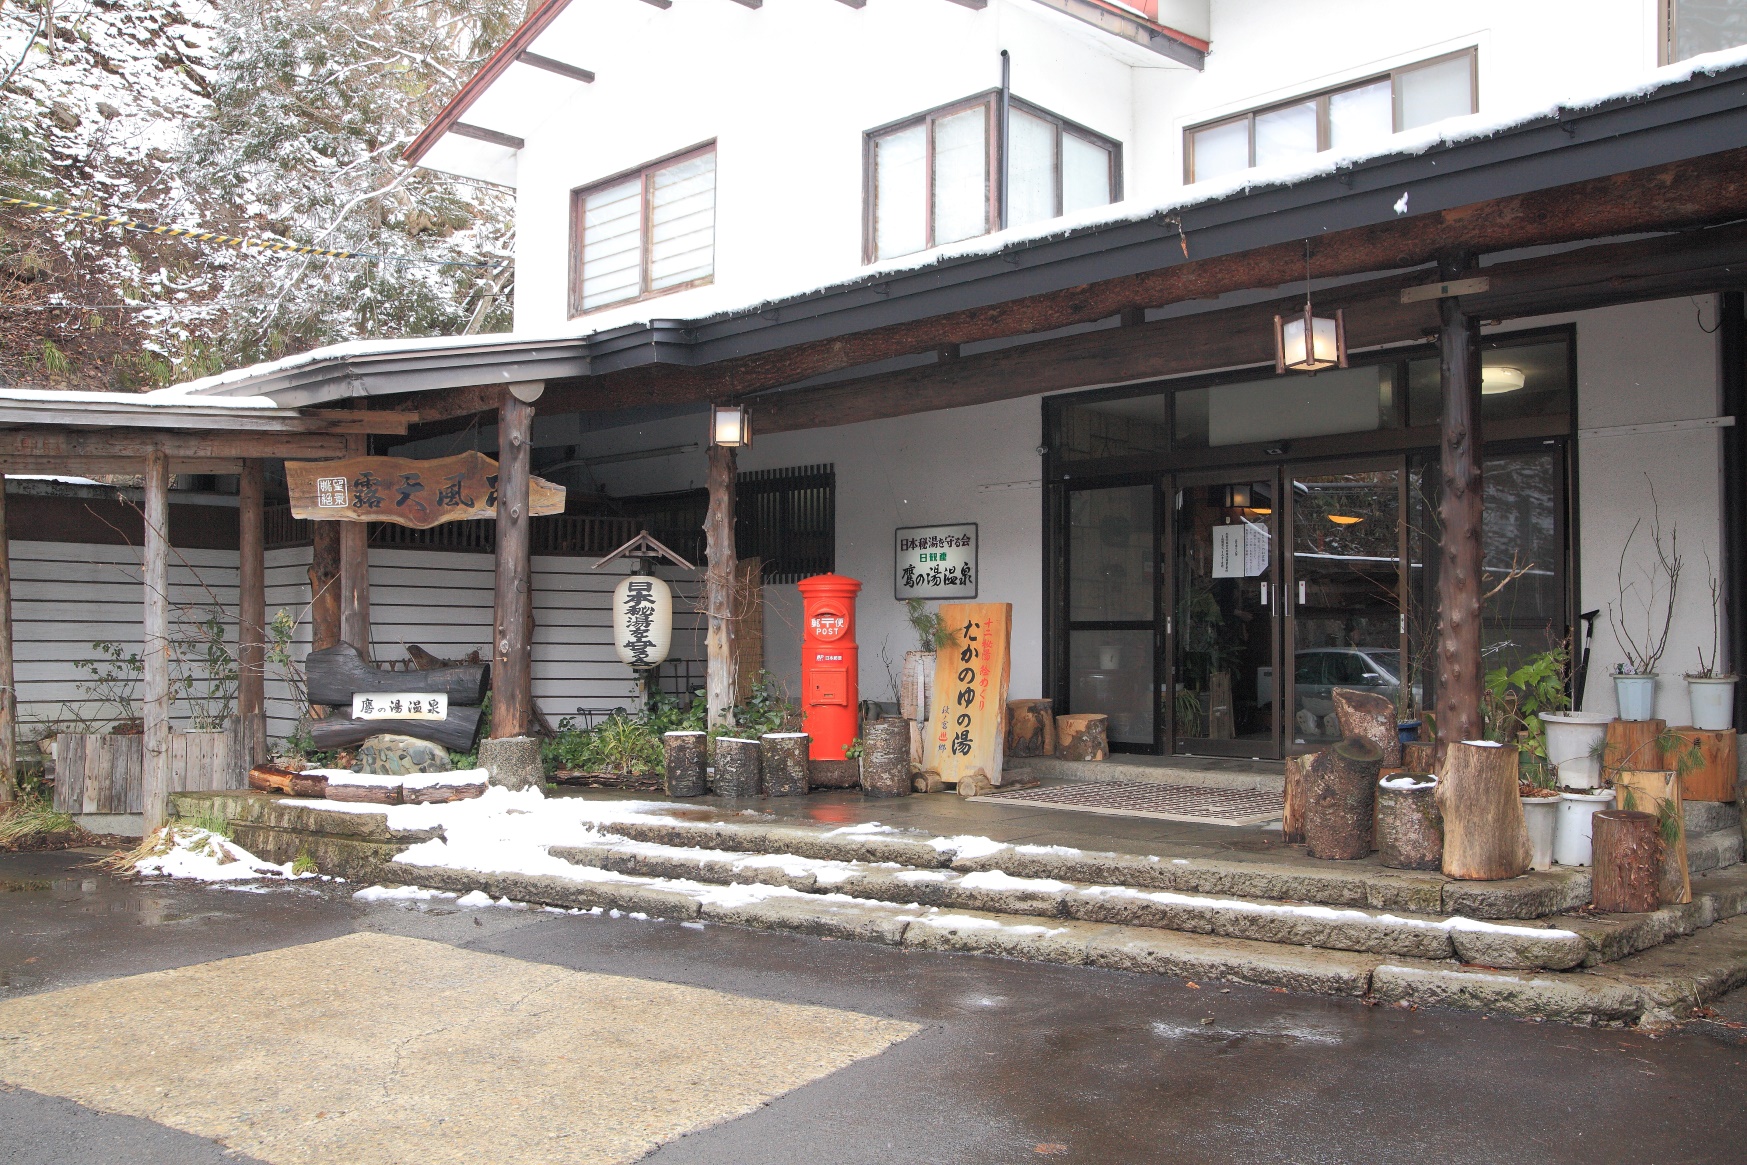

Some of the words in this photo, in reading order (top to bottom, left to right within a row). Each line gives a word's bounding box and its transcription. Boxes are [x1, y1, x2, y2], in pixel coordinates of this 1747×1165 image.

[901, 533, 971, 552] 日本秘湯を守る会
[901, 561, 973, 588] 鷹の湯温泉
[623, 581, 658, 667] 日本秘湯を守る会
[951, 619, 981, 756] たかのゆの湯
[360, 697, 441, 714] 鷹の湯温泉
